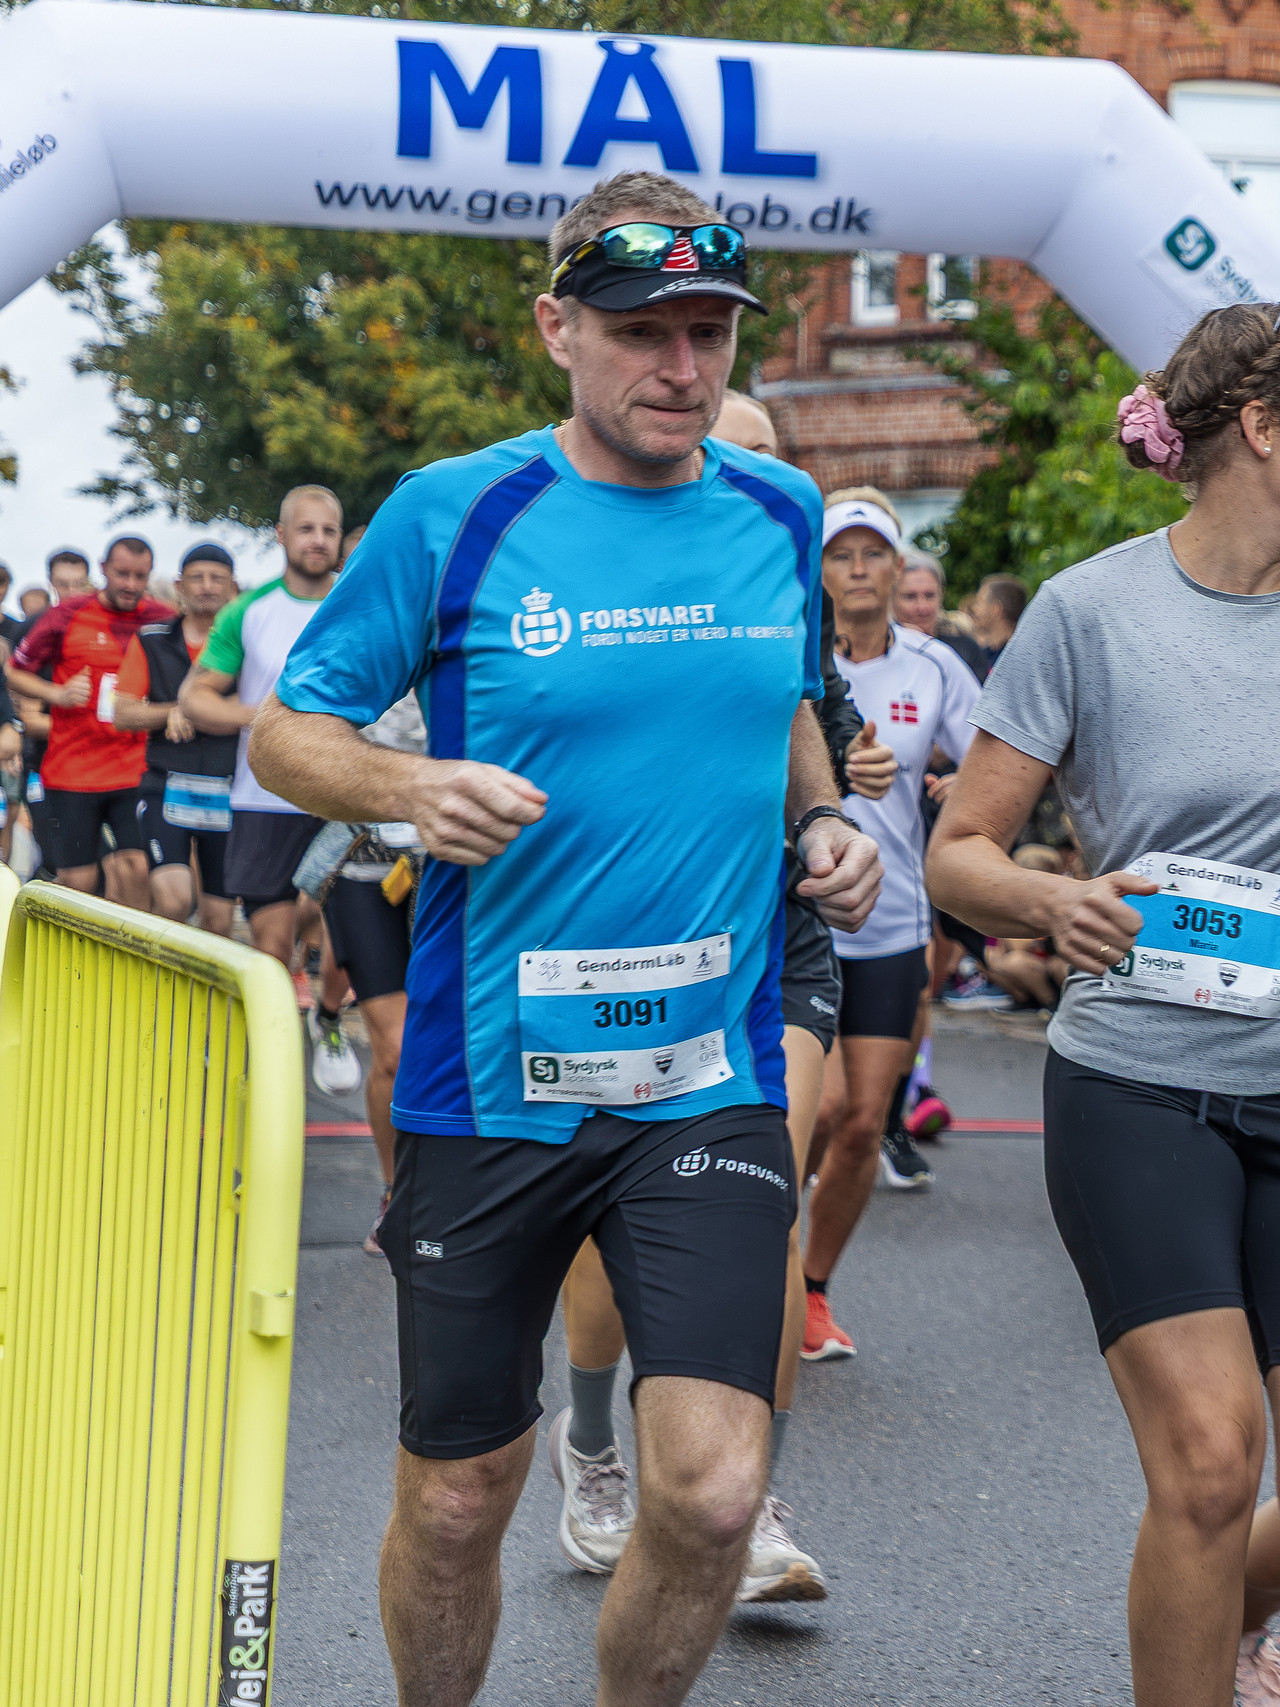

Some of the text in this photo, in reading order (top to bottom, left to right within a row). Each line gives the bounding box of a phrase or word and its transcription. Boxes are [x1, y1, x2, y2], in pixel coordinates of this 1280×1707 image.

[396, 37, 818, 179] MÅL
[578, 604, 716, 631] FORSVARET
[1172, 903, 1242, 939] 3053
[1139, 953, 1187, 971] Sydjysk
[593, 996, 668, 1029] 3091
[563, 1058, 619, 1075] Sydjysk
